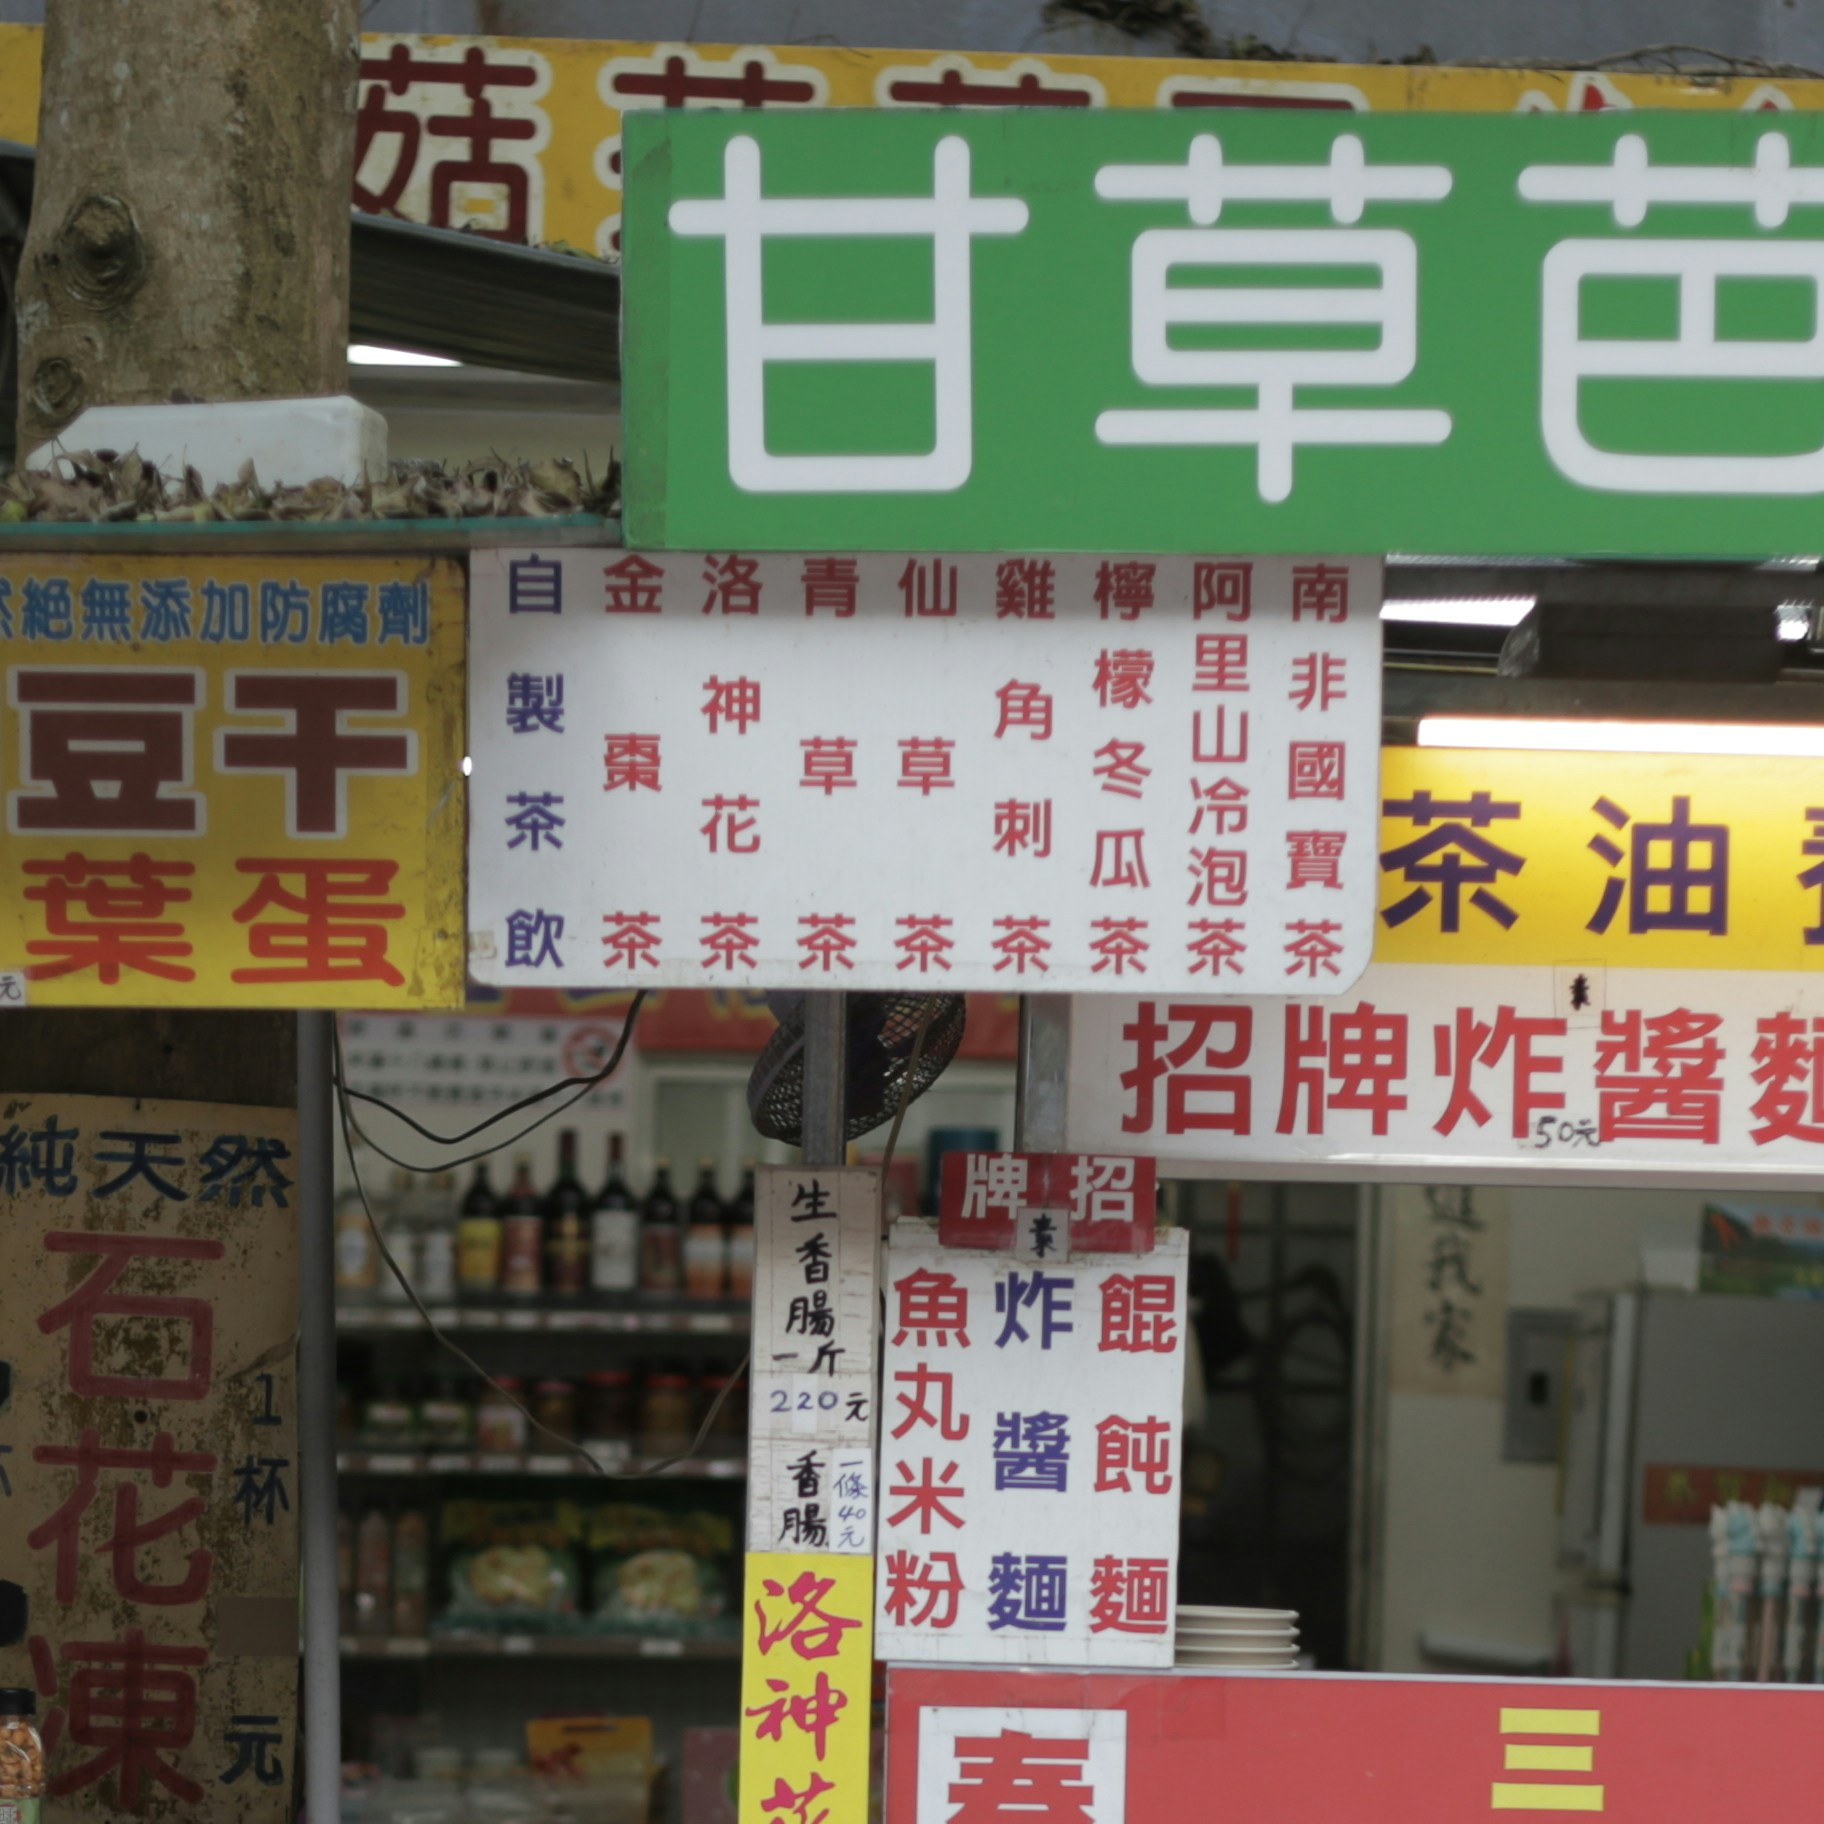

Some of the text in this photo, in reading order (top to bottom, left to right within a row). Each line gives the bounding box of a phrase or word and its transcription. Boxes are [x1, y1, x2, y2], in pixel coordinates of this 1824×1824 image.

[504, 552, 565, 970] 自製茶飲
[601, 553, 665, 973] 金棗茶
[699, 554, 764, 973] 洛神花茶
[796, 556, 860, 974] 青草茶
[894, 556, 959, 974] 仙草茶
[992, 556, 1057, 976] 雞角刺茶
[1088, 558, 1156, 978] 檸檬冬瓜茶
[1185, 560, 1254, 979] 阿里山冷泡茶
[1282, 562, 1350, 981] 南非國寶茶
[784, 1178, 838, 1338] 生香腸
[1533, 1112, 1602, 1153] 50元
[26, 1230, 226, 1808] 石花凍
[770, 1390, 871, 1423] 220元
[883, 1267, 971, 1632] 魚丸米粉
[986, 1271, 1074, 1635] 炸醬麵
[1090, 1273, 1178, 1636] 餛飩麵
